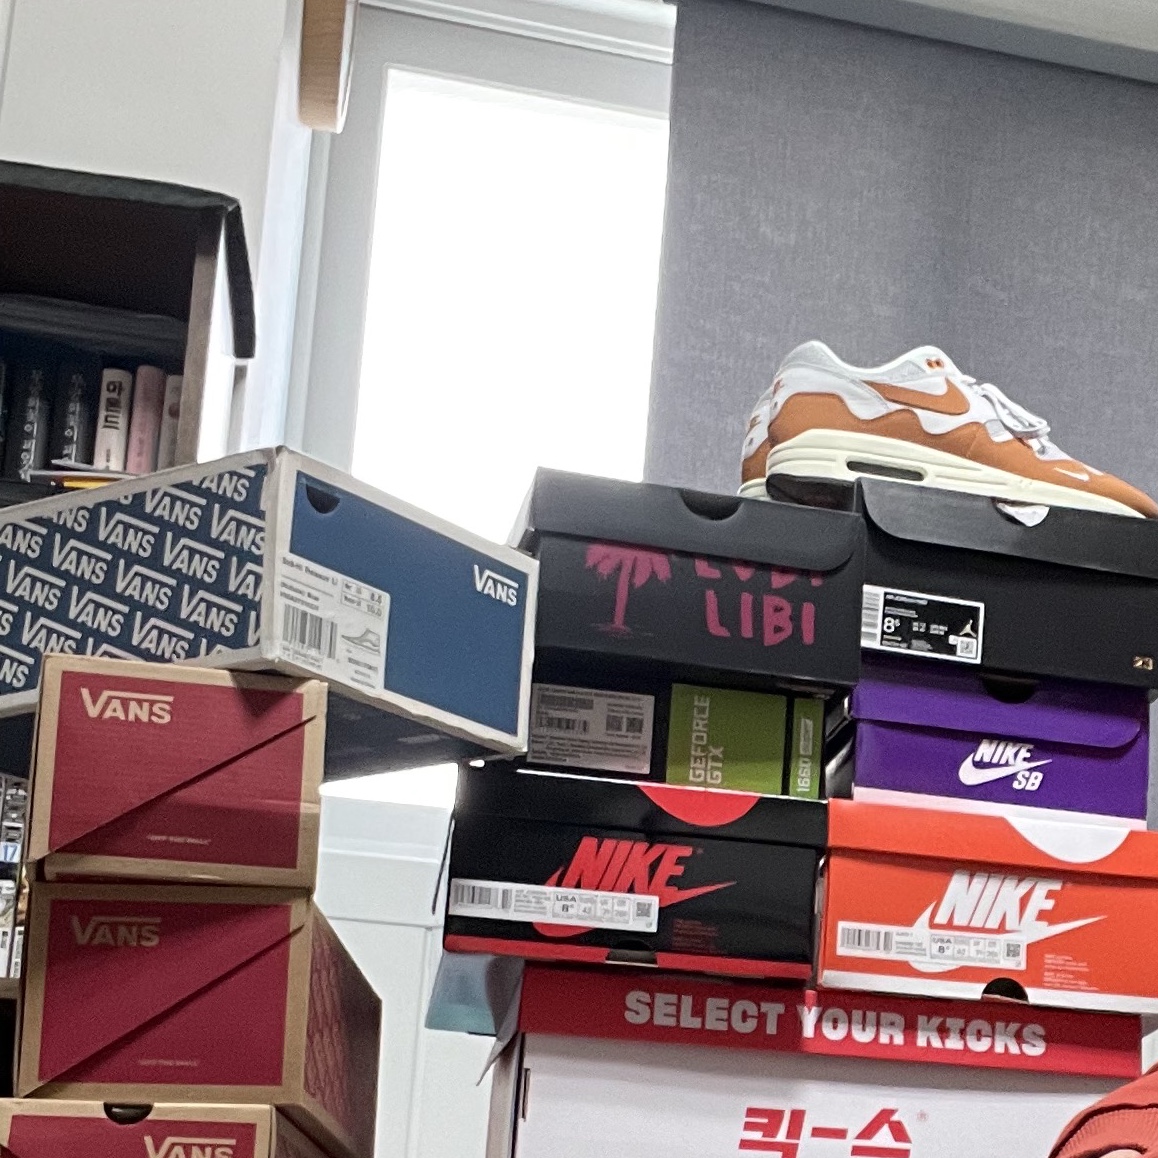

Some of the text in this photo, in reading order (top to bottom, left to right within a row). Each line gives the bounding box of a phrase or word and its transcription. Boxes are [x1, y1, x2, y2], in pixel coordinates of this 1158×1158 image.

[98, 507, 160, 558] VANS
[145, 485, 207, 530] VANS
[0, 519, 48, 559] ANS
[52, 532, 113, 584] VANS
[163, 531, 225, 583] VANS
[6, 559, 67, 611] VANS
[115, 557, 177, 610] VANS
[474, 564, 519, 607] VANS
[69, 585, 130, 637] VANS
[180, 583, 243, 637] VANS
[705, 589, 816, 647] LIBI
[131, 611, 195, 662] VANS
[81, 687, 175, 724] VANS
[689, 694, 711, 784] GEFORCE
[707, 745, 725, 785] GTX
[974, 738, 1035, 767] NIKE
[1012, 770, 1044, 791] SB
[559, 836, 693, 892] NIKE
[933, 868, 1063, 931] NIKE
[69, 914, 163, 947] VANS
[624, 989, 1047, 1058] SELECT YOUR KICKS
